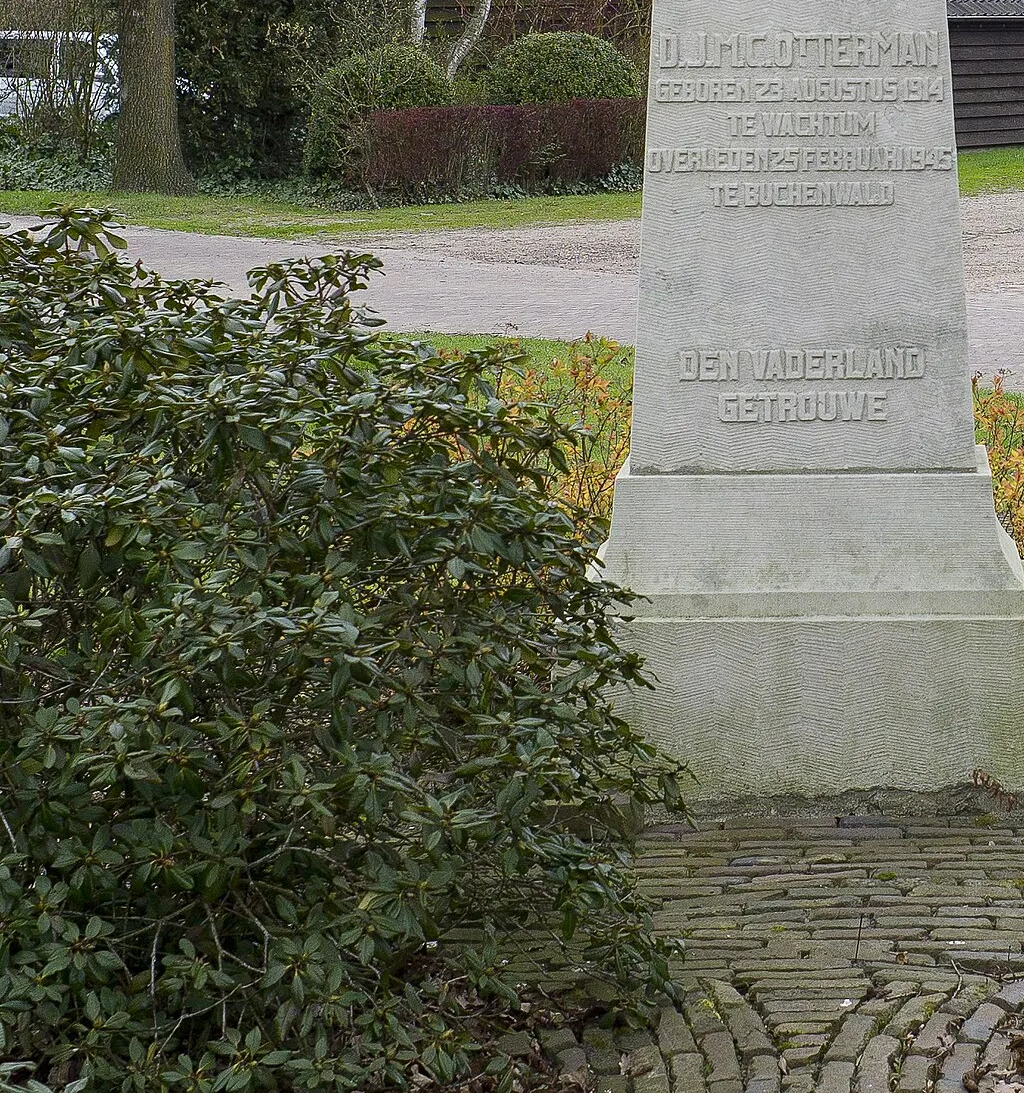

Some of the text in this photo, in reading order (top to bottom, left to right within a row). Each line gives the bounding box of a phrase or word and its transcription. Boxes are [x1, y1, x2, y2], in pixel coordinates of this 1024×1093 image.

[656, 77, 944, 103] GEBOREN 23 AUGUSTUS 1914
[727, 112, 876, 137] TE WACHTUM
[648, 146, 952, 173] OVERLEDEN 25 FEBRUARI 1945
[709, 182, 894, 207] TE BUCHENWALD
[680, 347, 925, 381] DEN VADERLAND
[719, 392, 887, 423] GETROUWE
